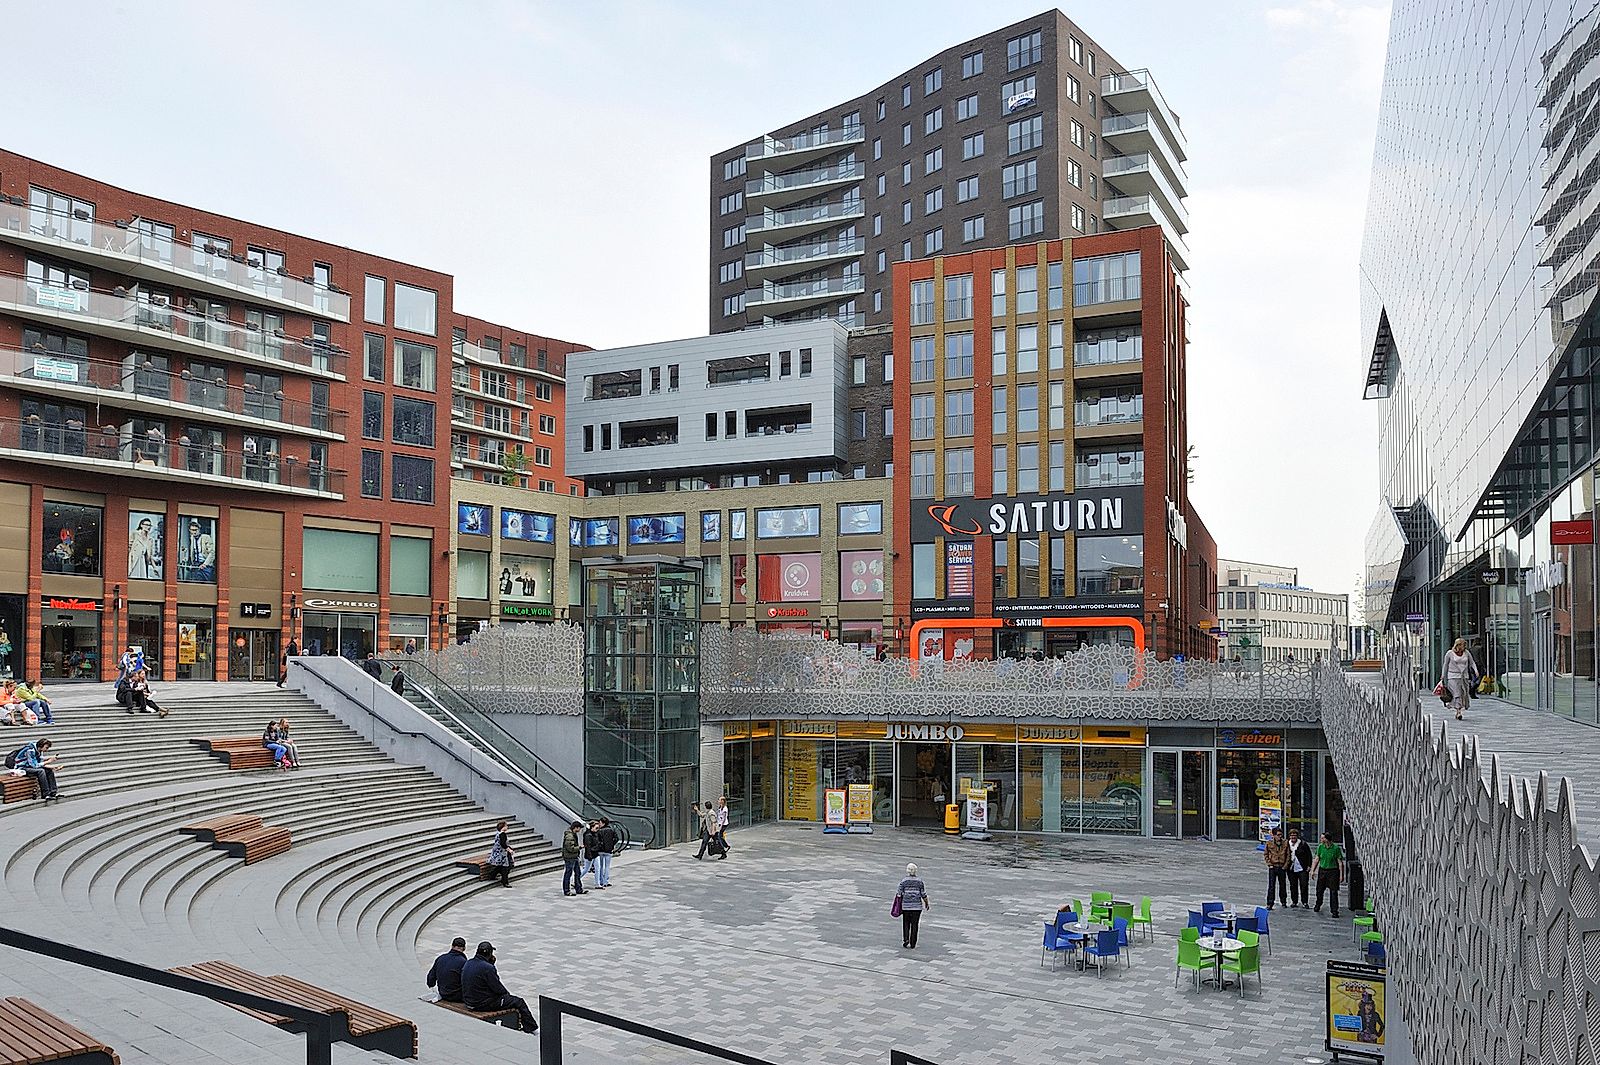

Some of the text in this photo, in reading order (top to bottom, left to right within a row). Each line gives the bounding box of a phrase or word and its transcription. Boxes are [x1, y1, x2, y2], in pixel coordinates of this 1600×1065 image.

[989, 498, 1122, 534] SATURN
[778, 608, 808, 616] Kruidvat
[1015, 618, 1042, 627] SATURN
[785, 722, 836, 734] JUMBO
[883, 724, 964, 741] JUMBO
[1022, 727, 1080, 740] JUMBO
